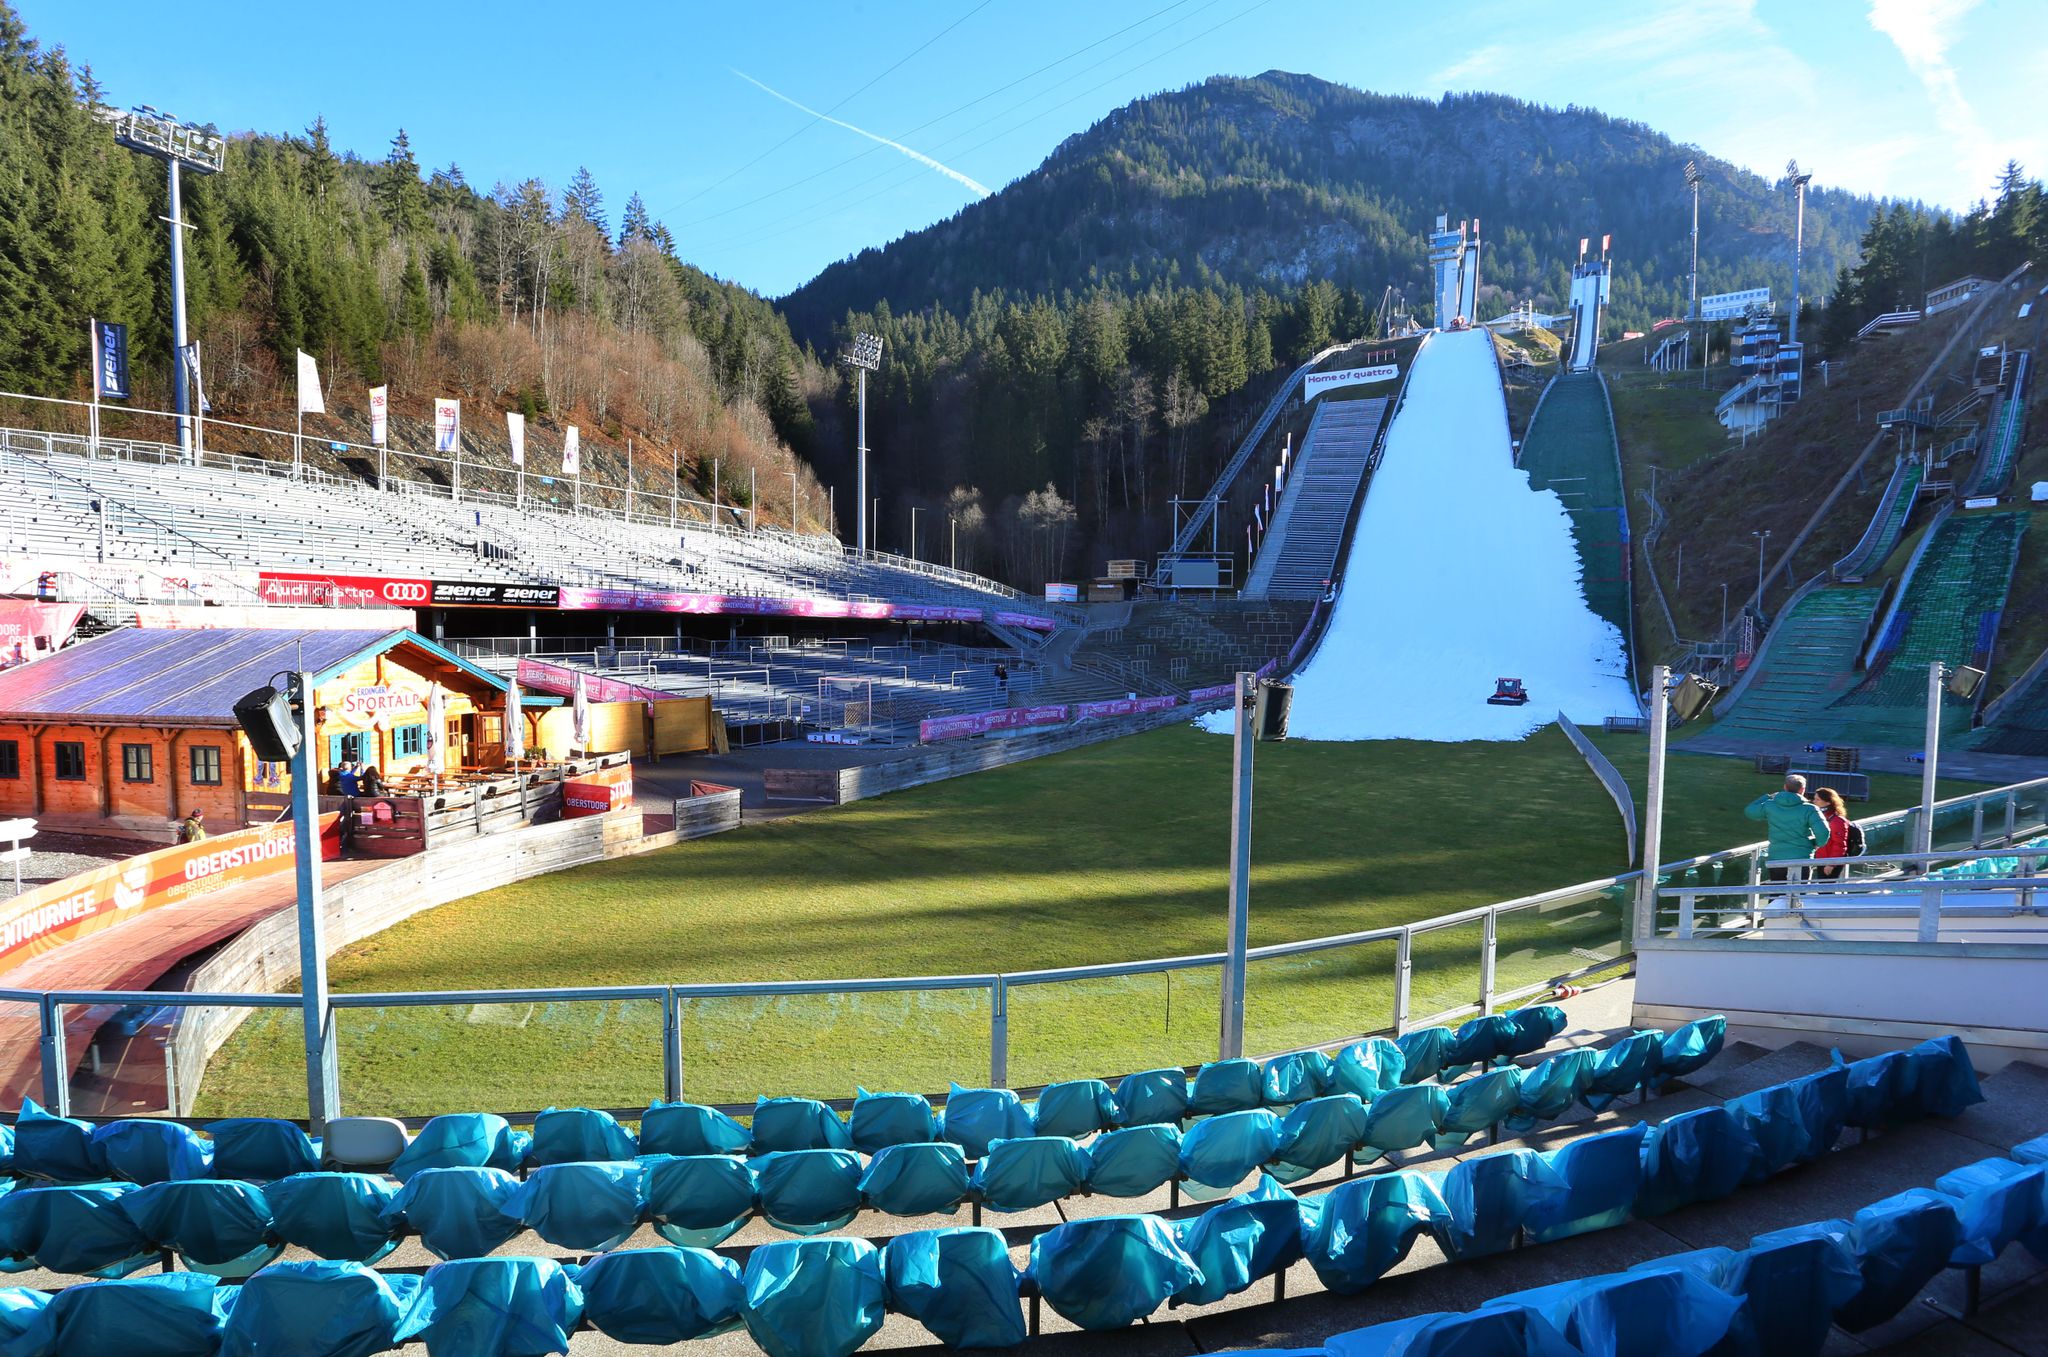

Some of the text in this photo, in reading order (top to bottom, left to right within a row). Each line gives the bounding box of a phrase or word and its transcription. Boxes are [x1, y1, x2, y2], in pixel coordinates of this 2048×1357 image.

[103, 324, 119, 391] ziener
[1307, 367, 1394, 384] Home of quattro
[266, 582, 308, 596] Audi
[434, 584, 558, 600] ziener ziener
[525, 669, 600, 694] VIERSCHANZENTNEE
[357, 686, 386, 697] ERDINGER
[566, 797, 609, 811] OBERSTDORF
[185, 836, 296, 880] OBERSTDORF
[167, 871, 226, 897] OBERSTDORF
